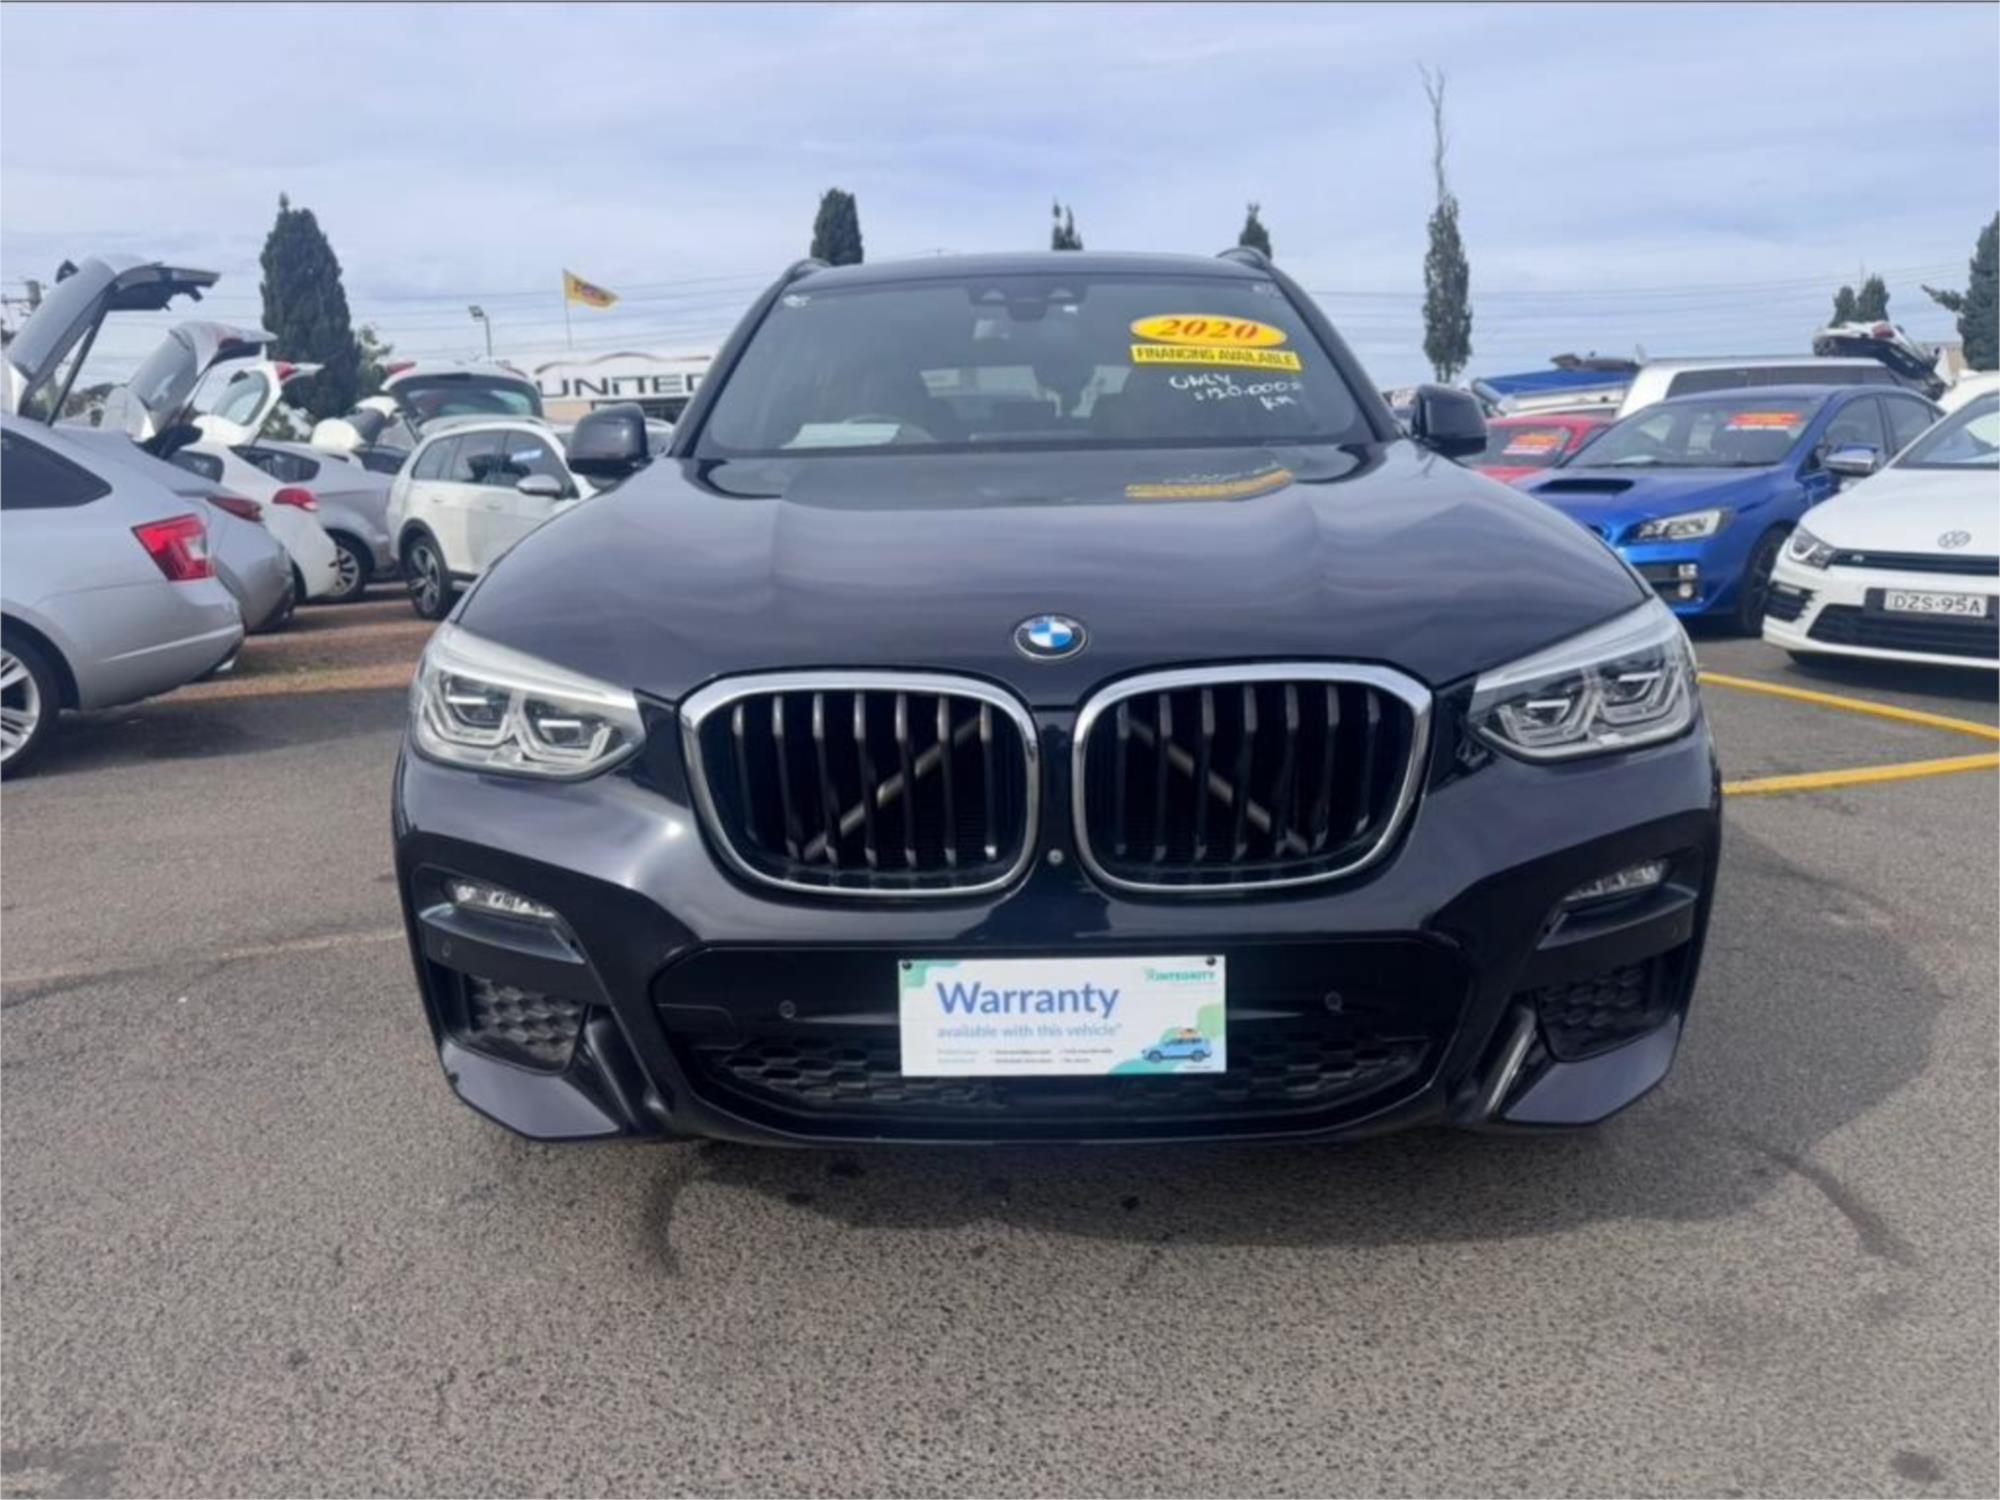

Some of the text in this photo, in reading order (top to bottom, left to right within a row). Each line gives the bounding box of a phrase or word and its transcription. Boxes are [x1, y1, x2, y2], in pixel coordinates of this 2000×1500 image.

[1156, 319, 1260, 340] 2020
[1136, 347, 1293, 366] FINANCING AVAILABLE
[936, 981, 1120, 1019] Warranty
[937, 1024, 997, 1039] available
[1002, 1023, 1034, 1037] with
[1037, 1023, 1063, 1037] this
